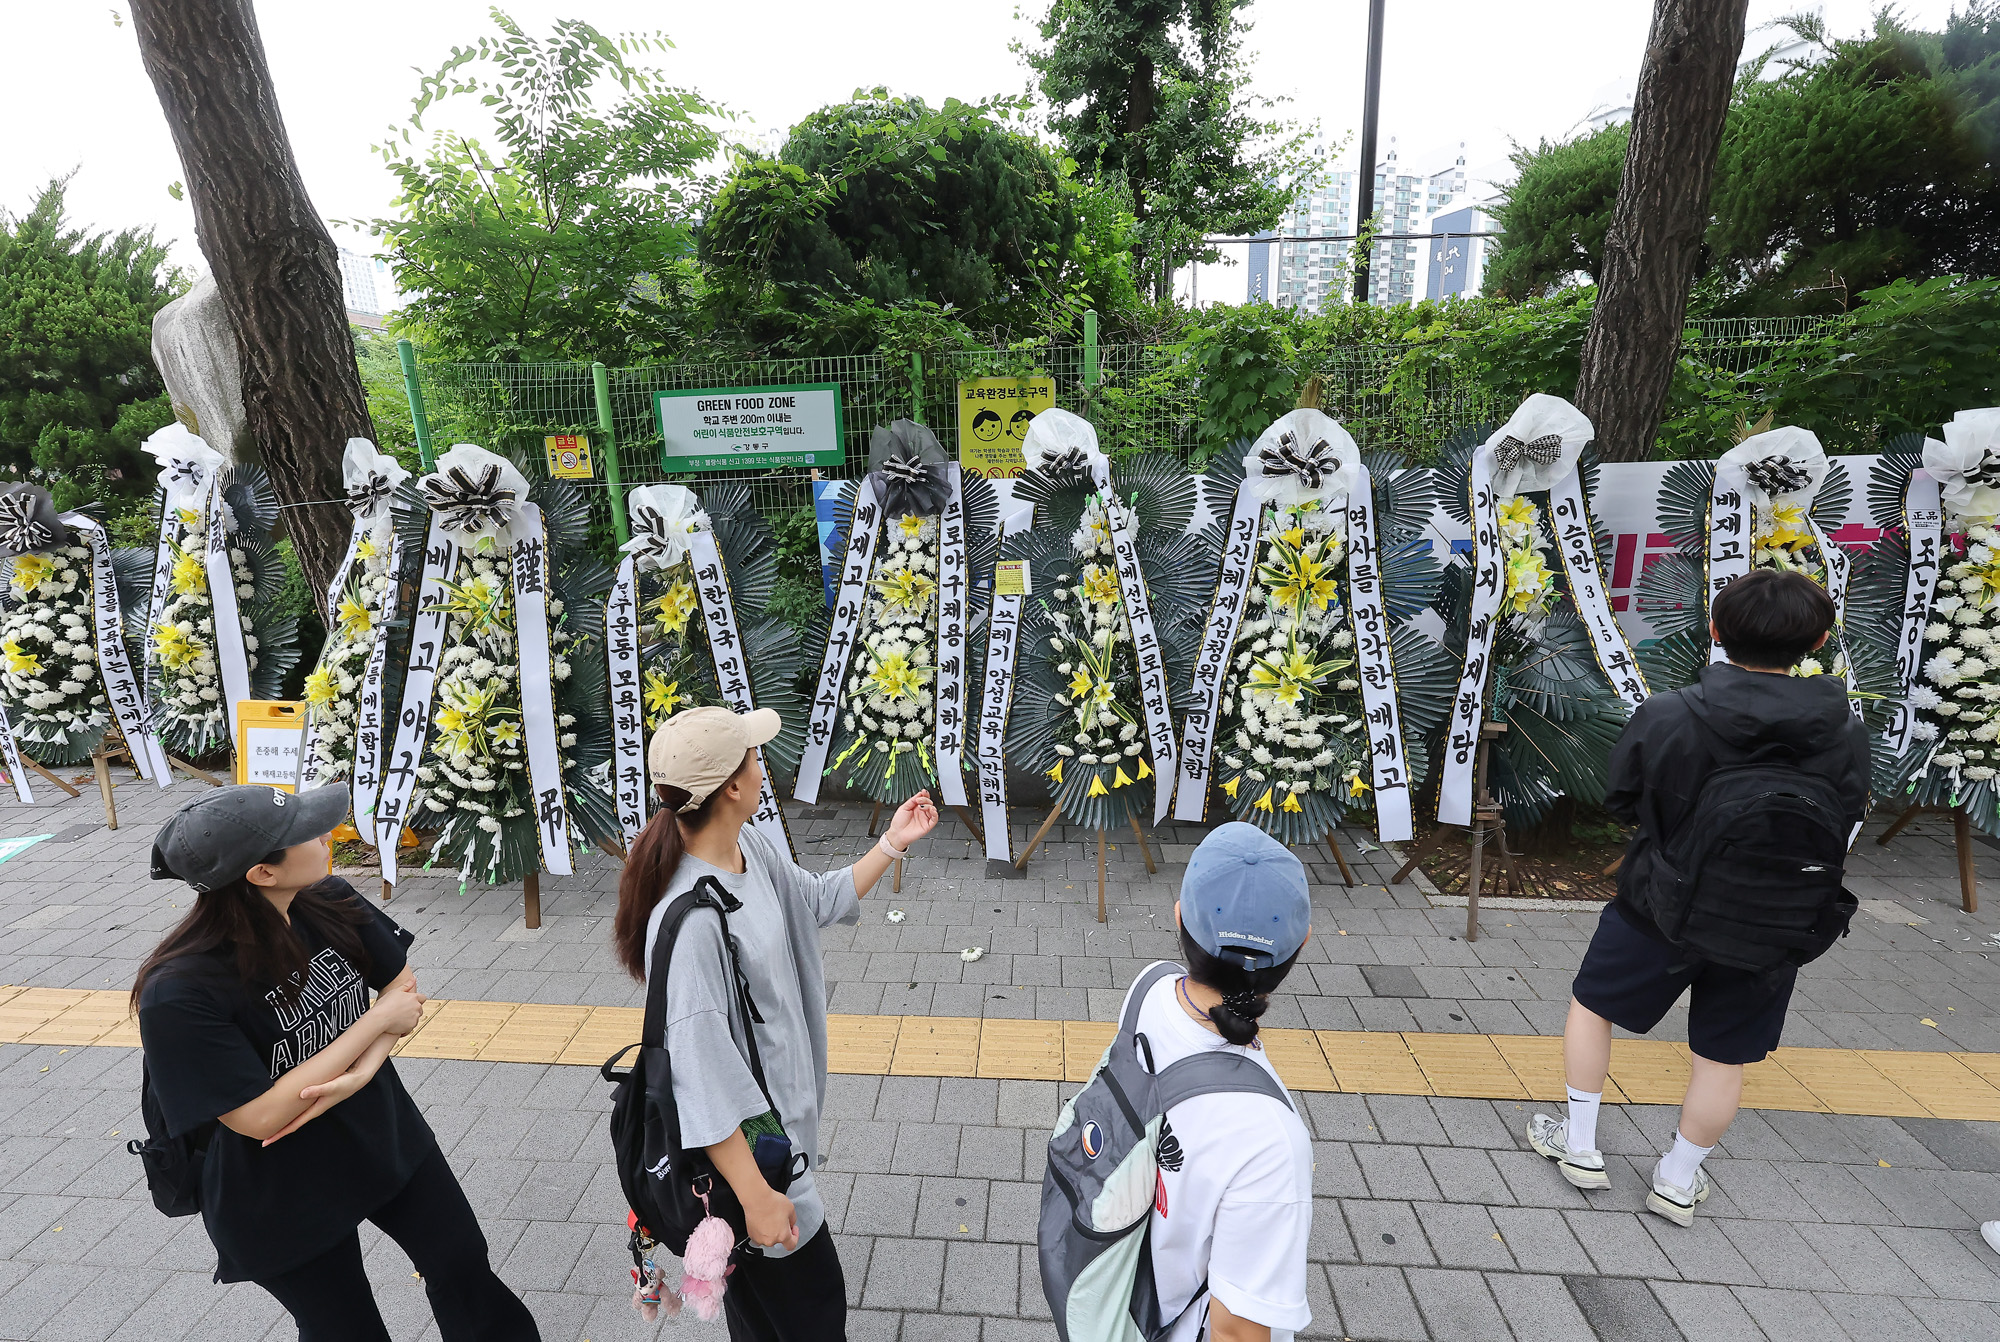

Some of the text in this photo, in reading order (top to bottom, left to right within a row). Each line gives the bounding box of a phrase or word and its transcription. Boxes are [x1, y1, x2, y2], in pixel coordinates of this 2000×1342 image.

[697, 396, 796, 412] GREEN FOOD ZONE
[703, 412, 792, 425] 학교 주변 200m 이내는
[965, 386, 1048, 400] 교육환경보호구역
[557, 437, 575, 445] 금연
[693, 426, 805, 439] 어린이 식품안전보호구역입니다.
[728, 457, 740, 466] 신고
[741, 457, 755, 465] 1399
[756, 456, 767, 465] 또는
[769, 455, 803, 464] 식품안전나라
[743, 443, 769, 451] 강동구
[1712, 488, 1744, 562] 배재고
[1912, 511, 1938, 520] 正品
[808, 502, 876, 746] 배재고 야구선수단
[940, 501, 964, 755] 프로야구채용 배제하라
[1556, 497, 1644, 704] 이승만 3.15 부정
[100, 618, 128, 673] 모욕하는
[697, 563, 735, 650] 대한민국
[719, 657, 750, 715] 민주주
[990, 609, 1017, 663] 쓰레기
[1117, 541, 1149, 624] 일베선수
[1137, 633, 1163, 716] 프로지명
[1151, 724, 1172, 761] 금지
[1349, 506, 1407, 792] 역사를 망각한 배재고
[376, 539, 452, 841] 배재고 야구부
[613, 670, 640, 756] 모욕하는
[983, 669, 1011, 739] 양성교육
[1452, 613, 1489, 765] 배재학당
[256, 746, 279, 756] 존중해
[357, 692, 379, 790] 애도합니다
[980, 749, 1005, 806] 그만해라
[1218, 931, 1274, 946] Hidden Behind
